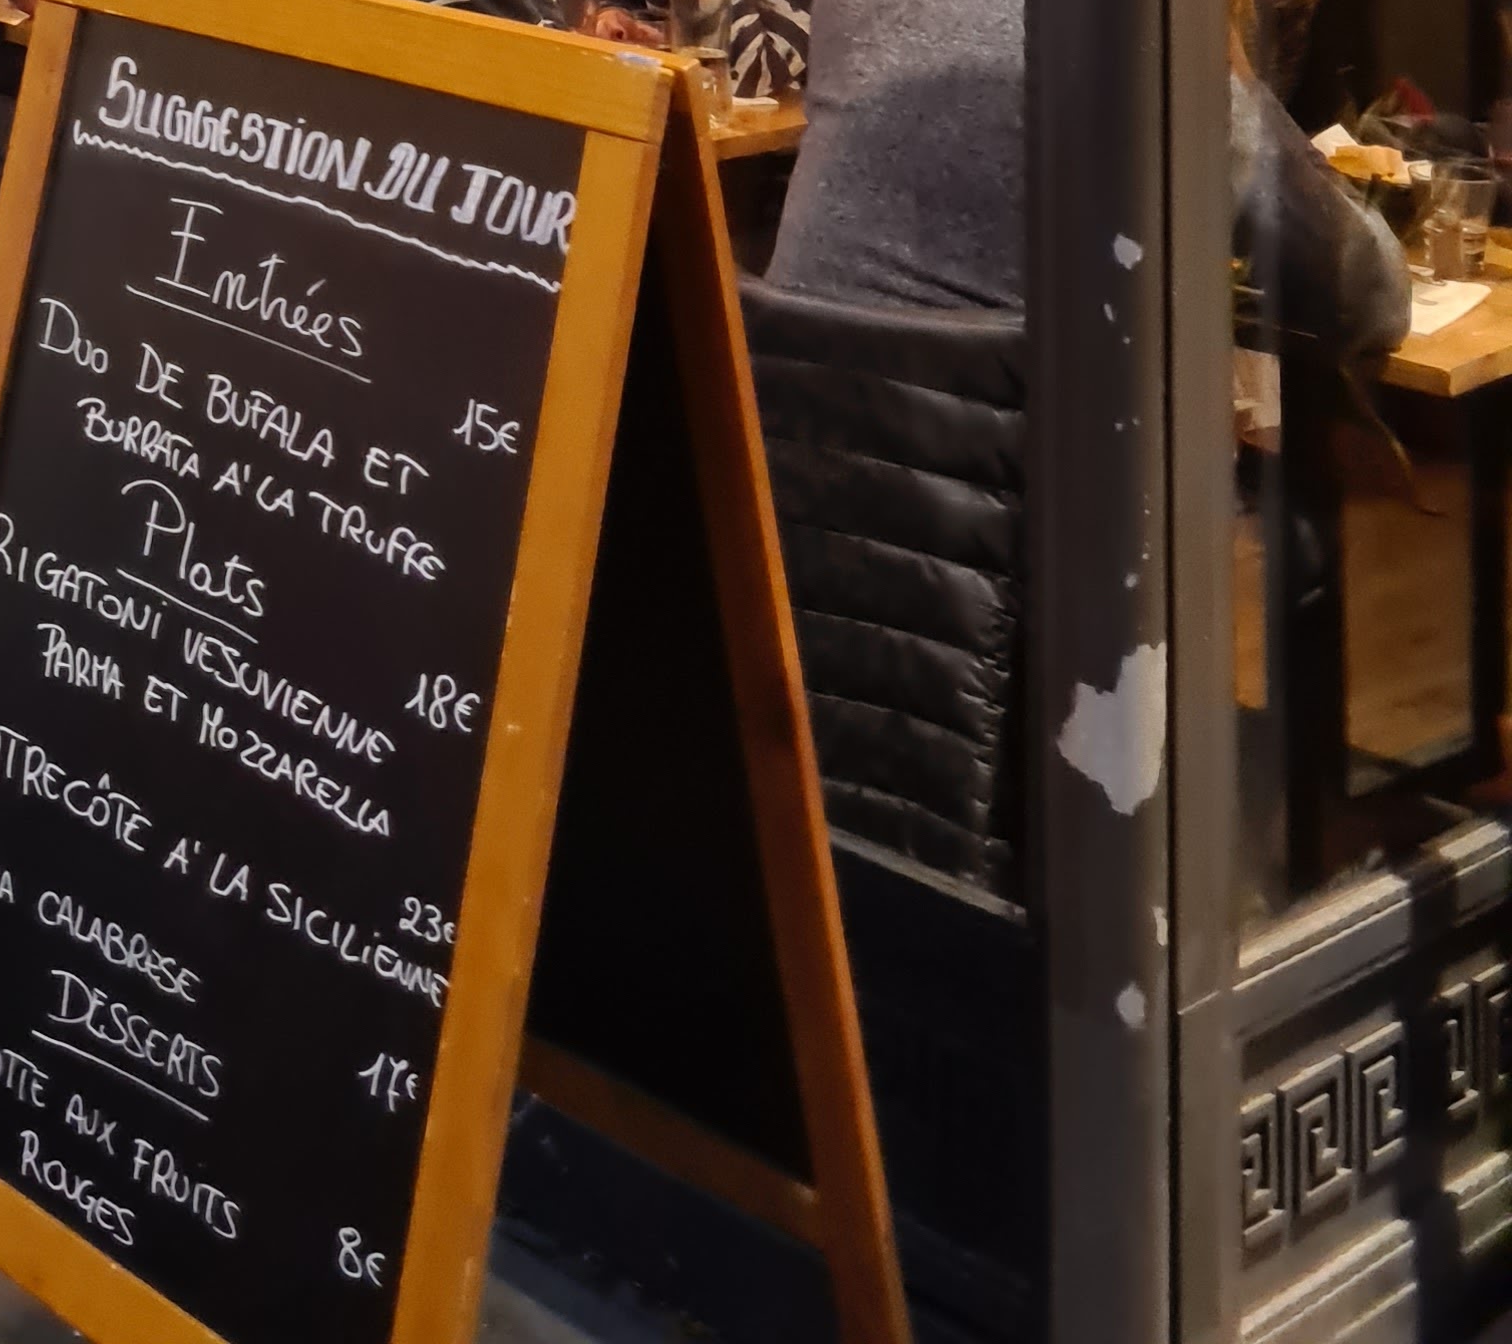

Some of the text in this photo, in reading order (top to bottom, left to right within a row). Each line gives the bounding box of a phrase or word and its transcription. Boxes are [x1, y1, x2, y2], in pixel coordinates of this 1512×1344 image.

[97, 55, 578, 253] SUGGESTION DU JOUR
[76, 397, 201, 479] BURRATA
[308, 489, 446, 583] TRUFFE
[135, 343, 186, 409] DE
[206, 373, 336, 469] BUFALA
[363, 446, 430, 495] ET
[453, 398, 521, 455] 15€
[120, 477, 266, 619] Plats
[36, 622, 390, 838] PARMA ET MOZZARELLA
[182, 627, 396, 767] VESUVIENNE
[404, 673, 481, 734] 18€
[37, 888, 202, 1004] CALABRESE
[208, 851, 250, 902] LA
[265, 882, 451, 1008] SICILIENNE
[47, 968, 223, 1098] DESSERTS
[18, 1128, 386, 1288] ROUGES 8€
[64, 1093, 118, 1156] AUX
[132, 1137, 241, 1240] FRUITS
